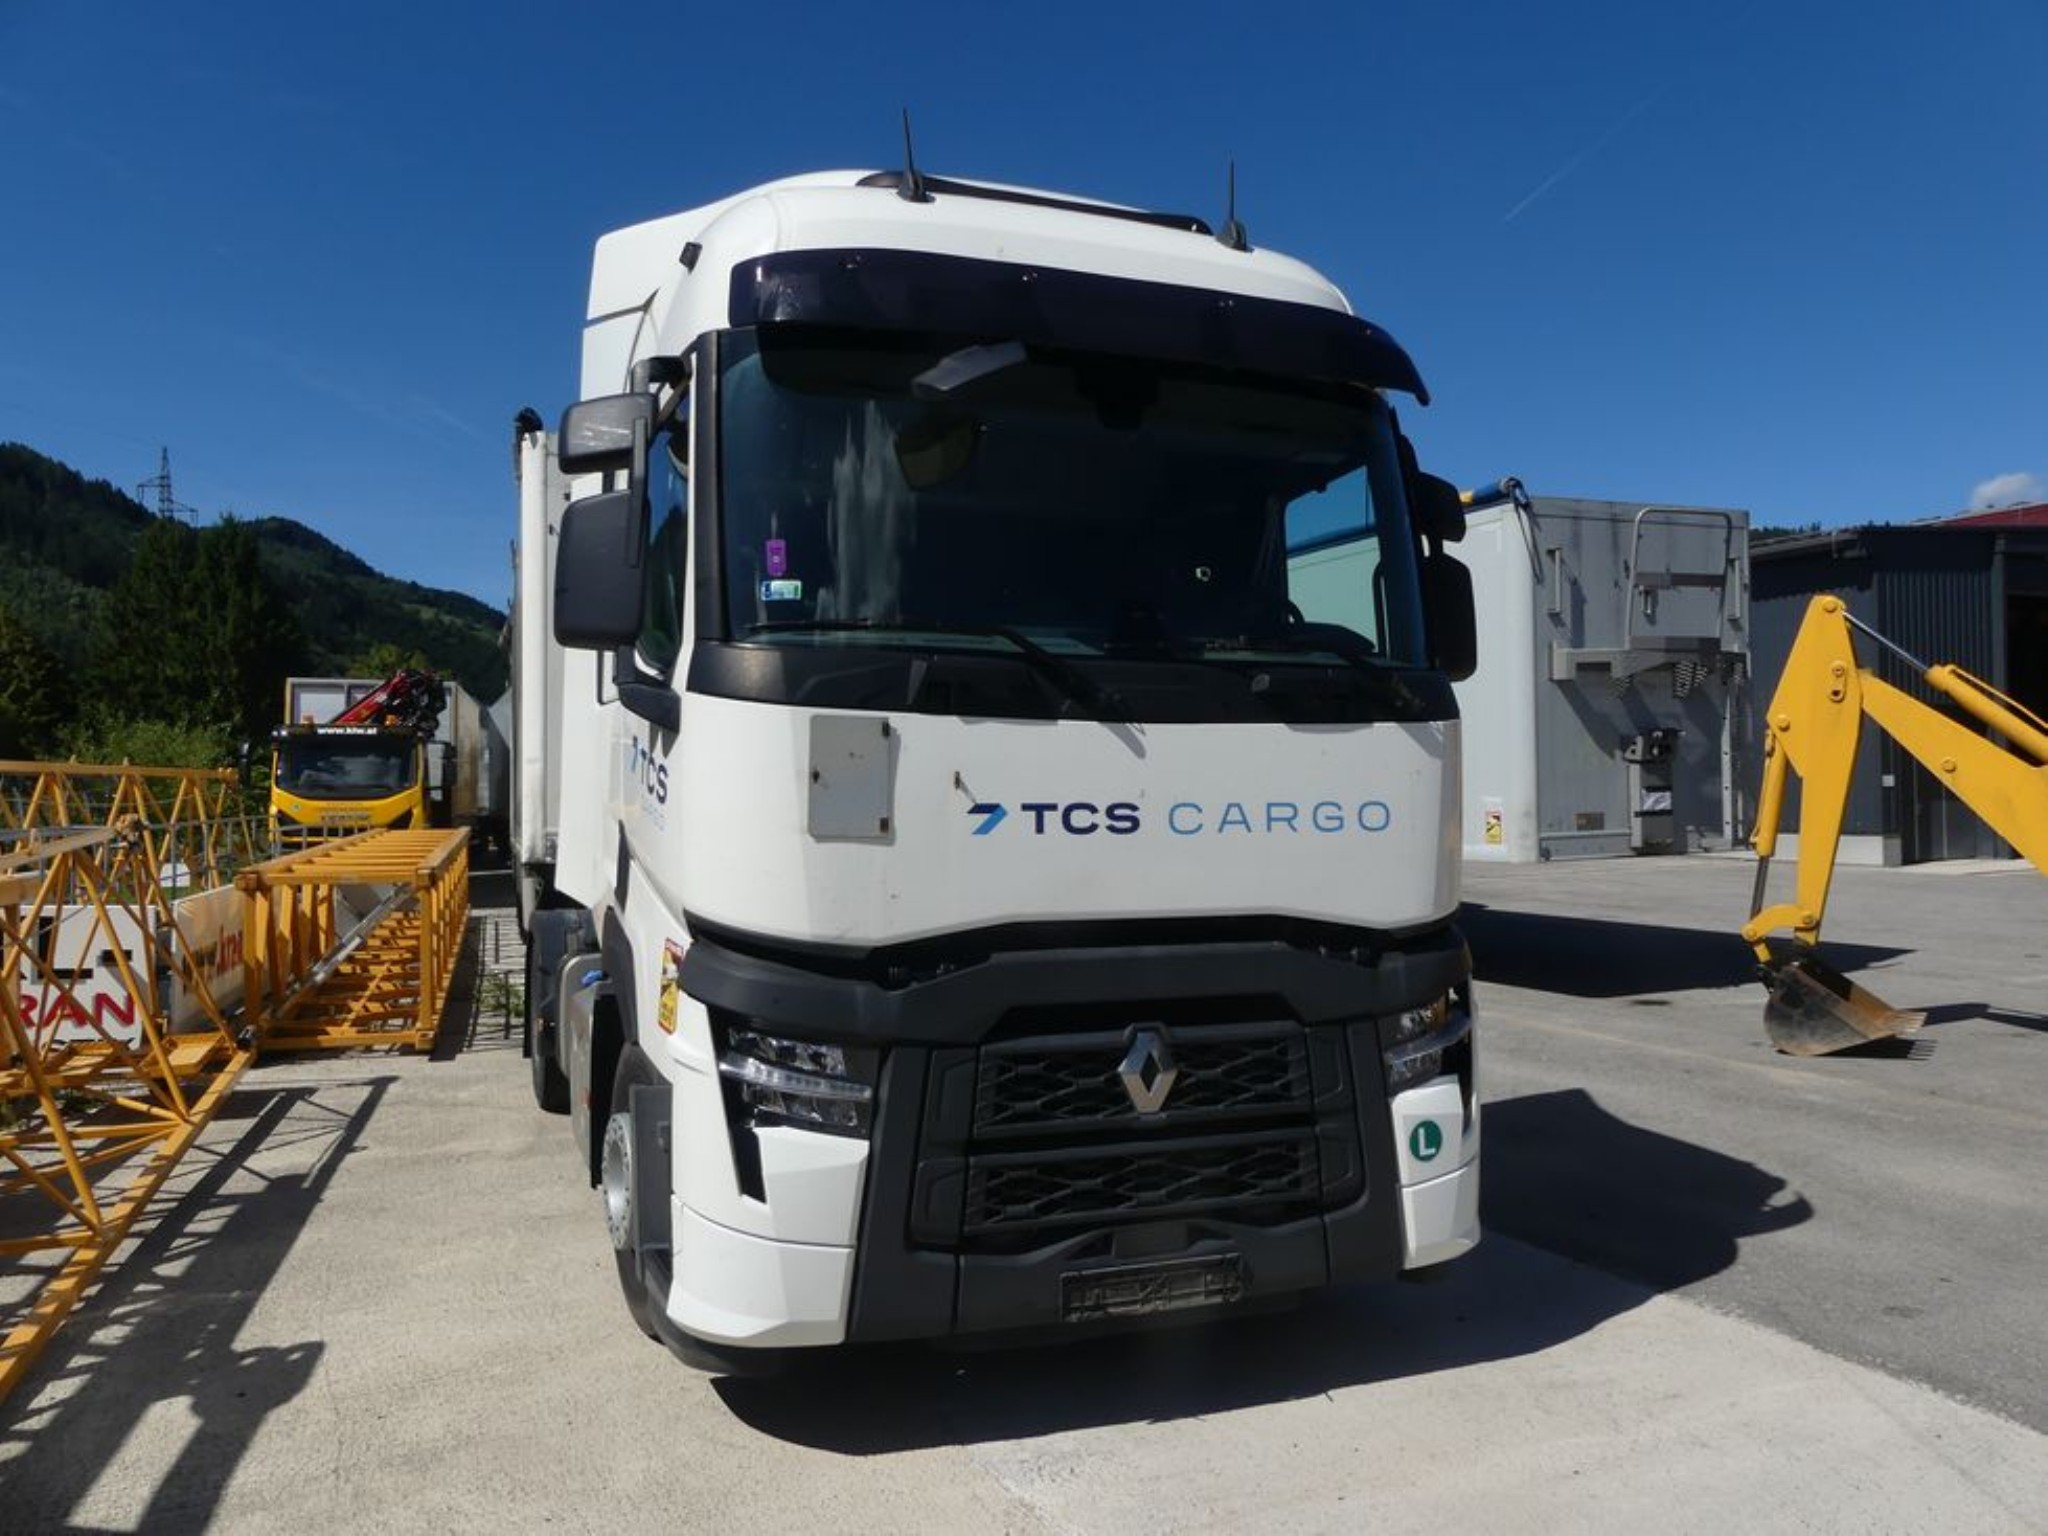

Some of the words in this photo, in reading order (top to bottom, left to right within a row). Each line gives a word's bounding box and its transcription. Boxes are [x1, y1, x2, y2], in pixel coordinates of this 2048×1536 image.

[1021, 803, 1141, 835] TCS
[1168, 801, 1391, 835] CARGO
[1418, 1127, 1437, 1157] L
